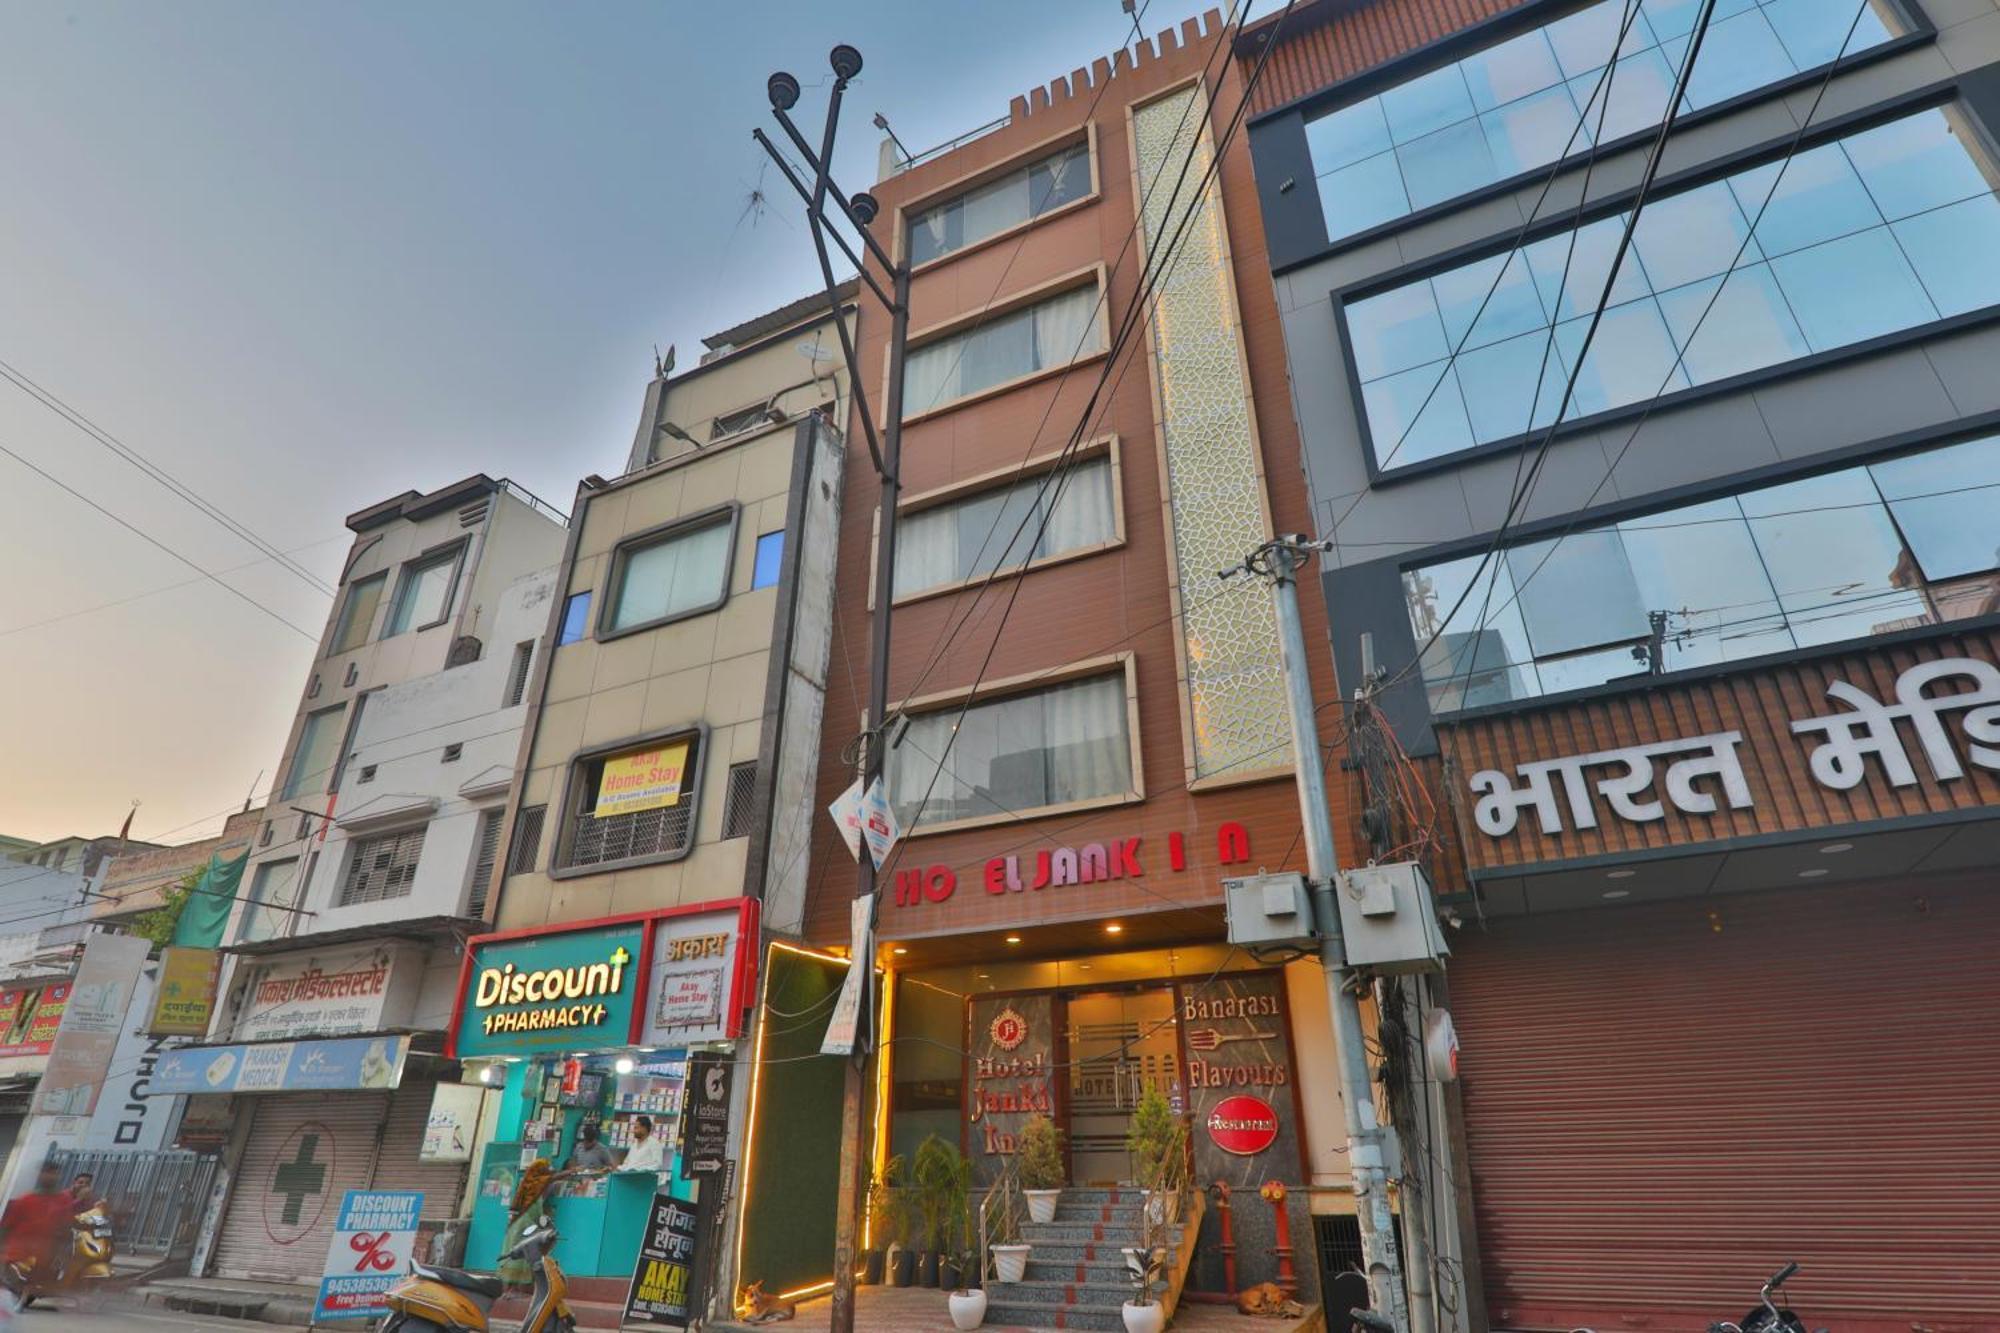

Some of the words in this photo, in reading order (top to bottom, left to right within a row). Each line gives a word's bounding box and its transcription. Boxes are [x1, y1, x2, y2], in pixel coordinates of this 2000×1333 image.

[605, 775, 644, 791] Home
[650, 768, 680, 784] Stay
[1470, 730, 1754, 836] भारत
[666, 933, 729, 961] अकाय
[475, 947, 629, 1008] Discount
[681, 981, 699, 992] Akay
[669, 995, 689, 1004] Home
[691, 992, 708, 1003] Stay
[1184, 996, 1280, 1021] Banarasi
[493, 1005, 592, 1033] PHARMACY
[246, 1045, 289, 1066] PRAKASH
[976, 1053, 1046, 1079] Hotel
[241, 1067, 282, 1088] MEDICAL
[1188, 1061, 1286, 1088] Flavours
[971, 1082, 1051, 1122] Janki
[352, 1196, 417, 1212] DISCOUNT
[344, 1212, 415, 1230] PHARMACY
